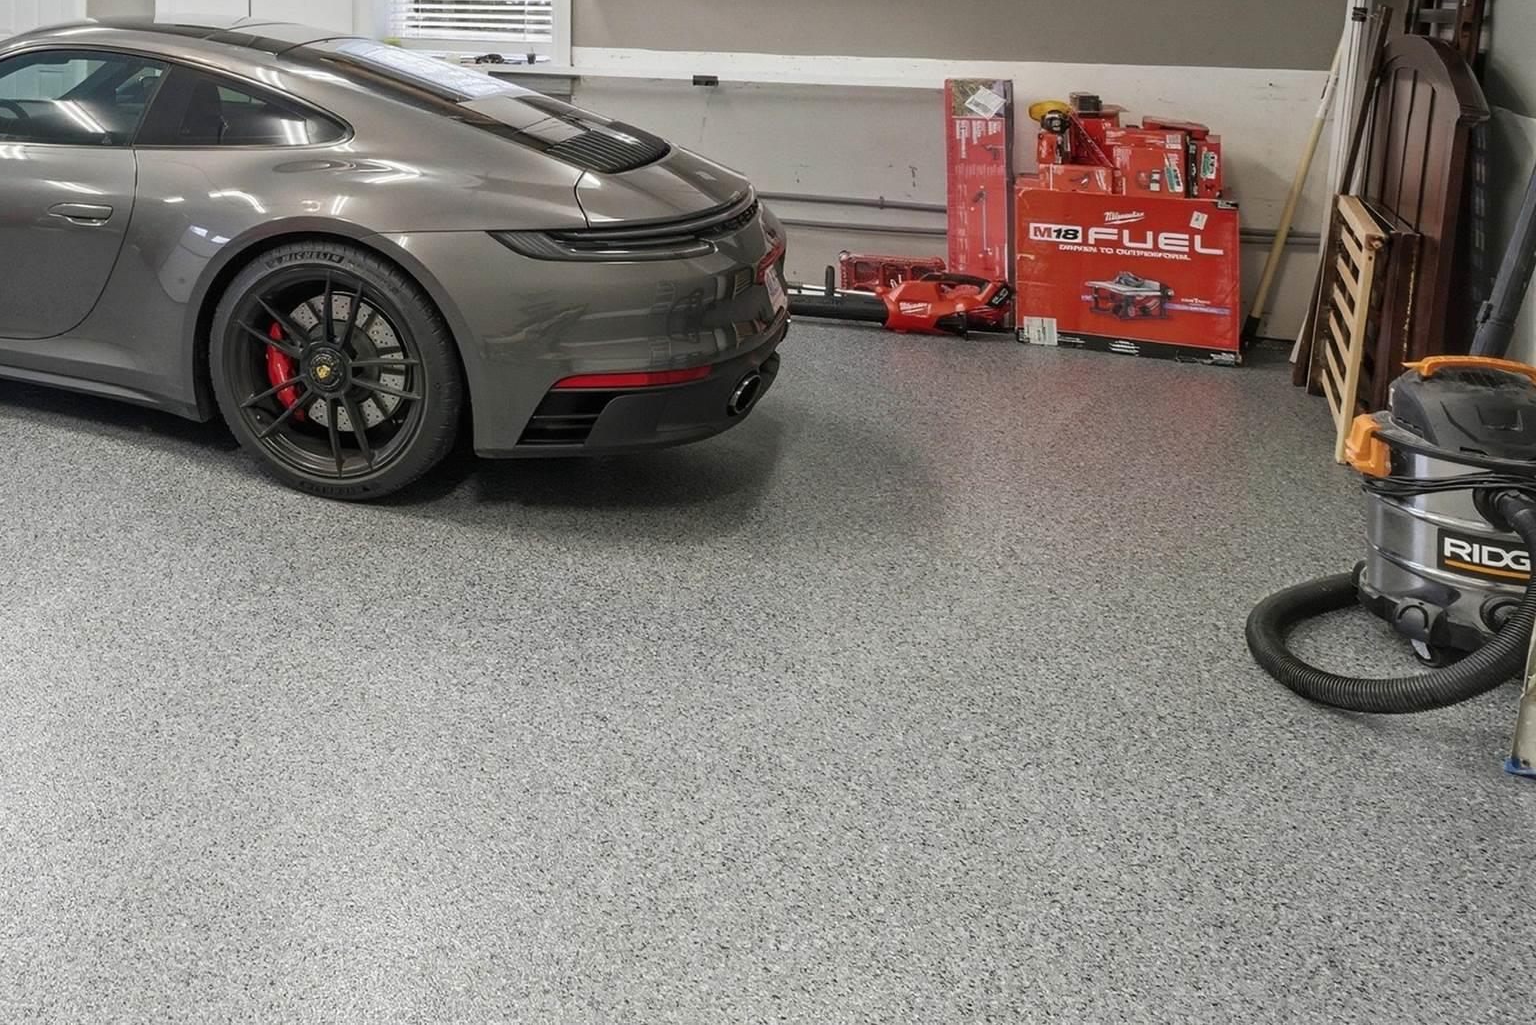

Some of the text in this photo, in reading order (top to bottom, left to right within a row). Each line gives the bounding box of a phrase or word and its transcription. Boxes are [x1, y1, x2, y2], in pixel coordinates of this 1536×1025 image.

[1033, 225, 1224, 256] M18 FUEL
[1058, 243, 1098, 254] DRIVEN
[1099, 246, 1114, 255] TO
